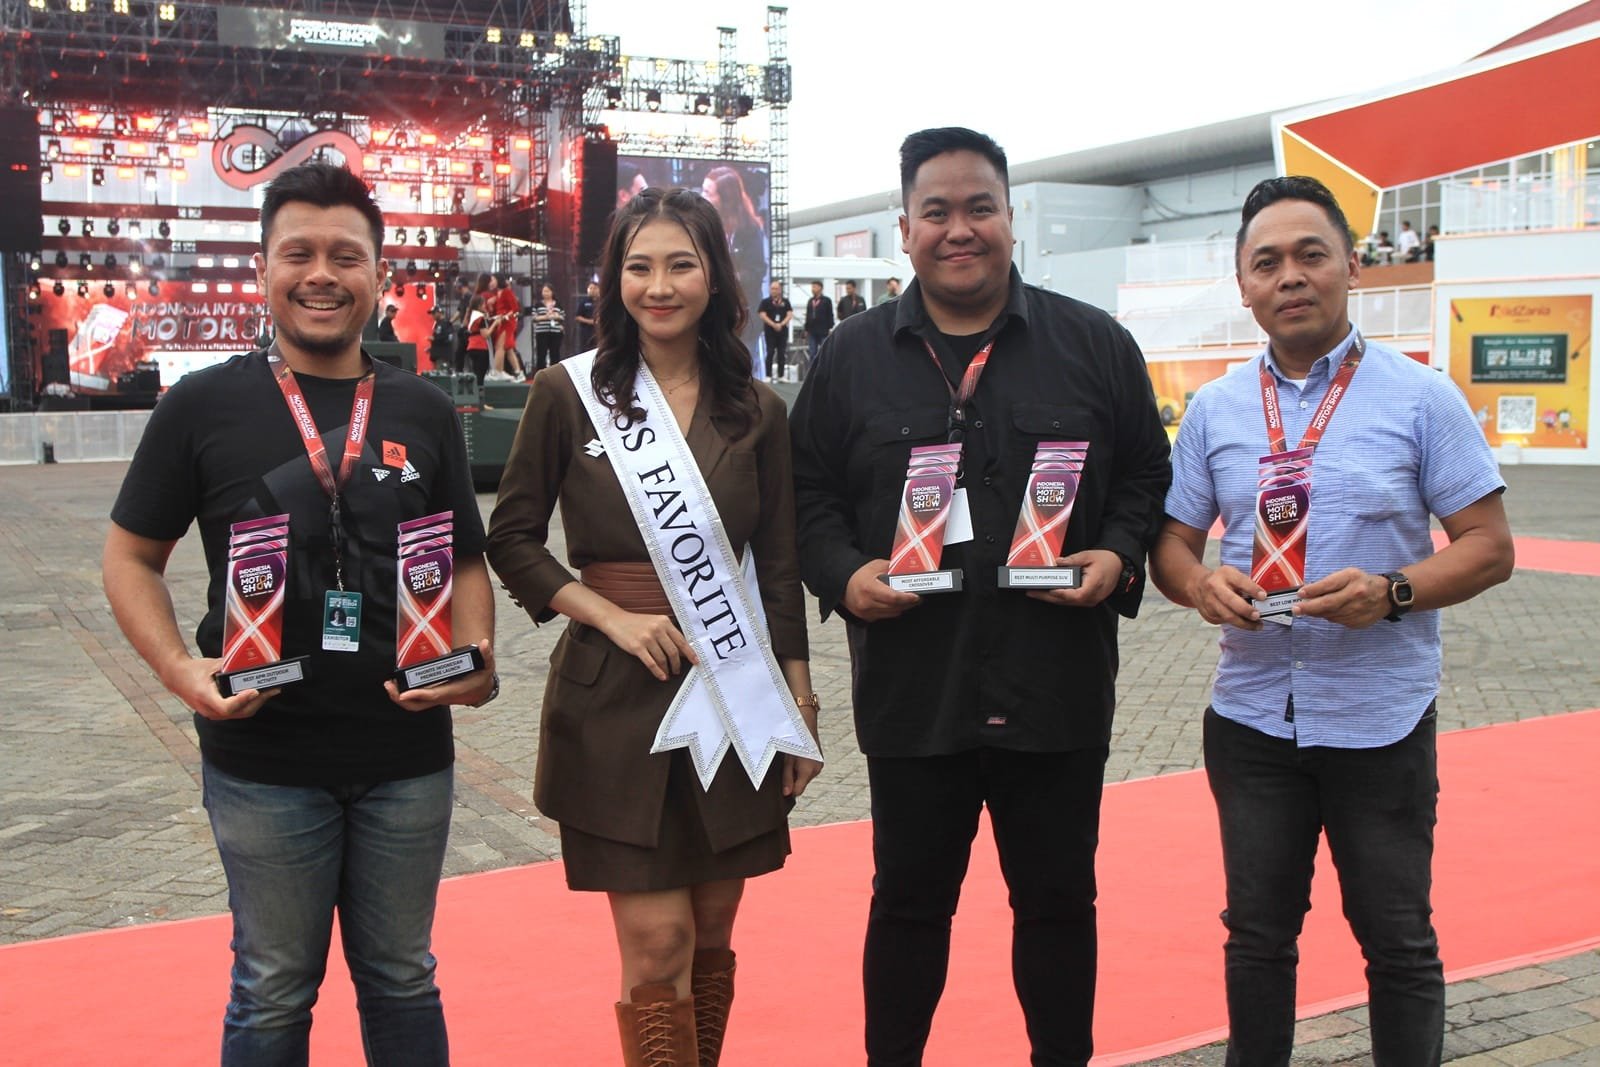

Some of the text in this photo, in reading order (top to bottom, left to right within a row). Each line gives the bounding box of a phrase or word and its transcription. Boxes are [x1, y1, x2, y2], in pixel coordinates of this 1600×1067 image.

[290, 26, 378, 42] MOTOR SHOW
[131, 317, 273, 341] MOTOR SH
[1264, 388, 1273, 410] MOTOR
[1316, 385, 1344, 430] MOTOR SHOW
[292, 394, 318, 439] MOTOR SHOW
[351, 398, 364, 441] MOTOR SHOW
[913, 500, 940, 509] SHOW
[1036, 495, 1064, 503] SHOW
[1267, 503, 1297, 514] MOTOR
[1269, 511, 1296, 521] SHOW
[637, 460, 747, 660] FAVORITE
[241, 573, 273, 585] MOTOR
[411, 569, 441, 582] MOTOR
[412, 577, 441, 590] SHOW
[242, 581, 273, 593] SHOW
[415, 659, 464, 677] FAVORITE INDONESIAN
[420, 665, 462, 681] PREMIERE LAUNCH
